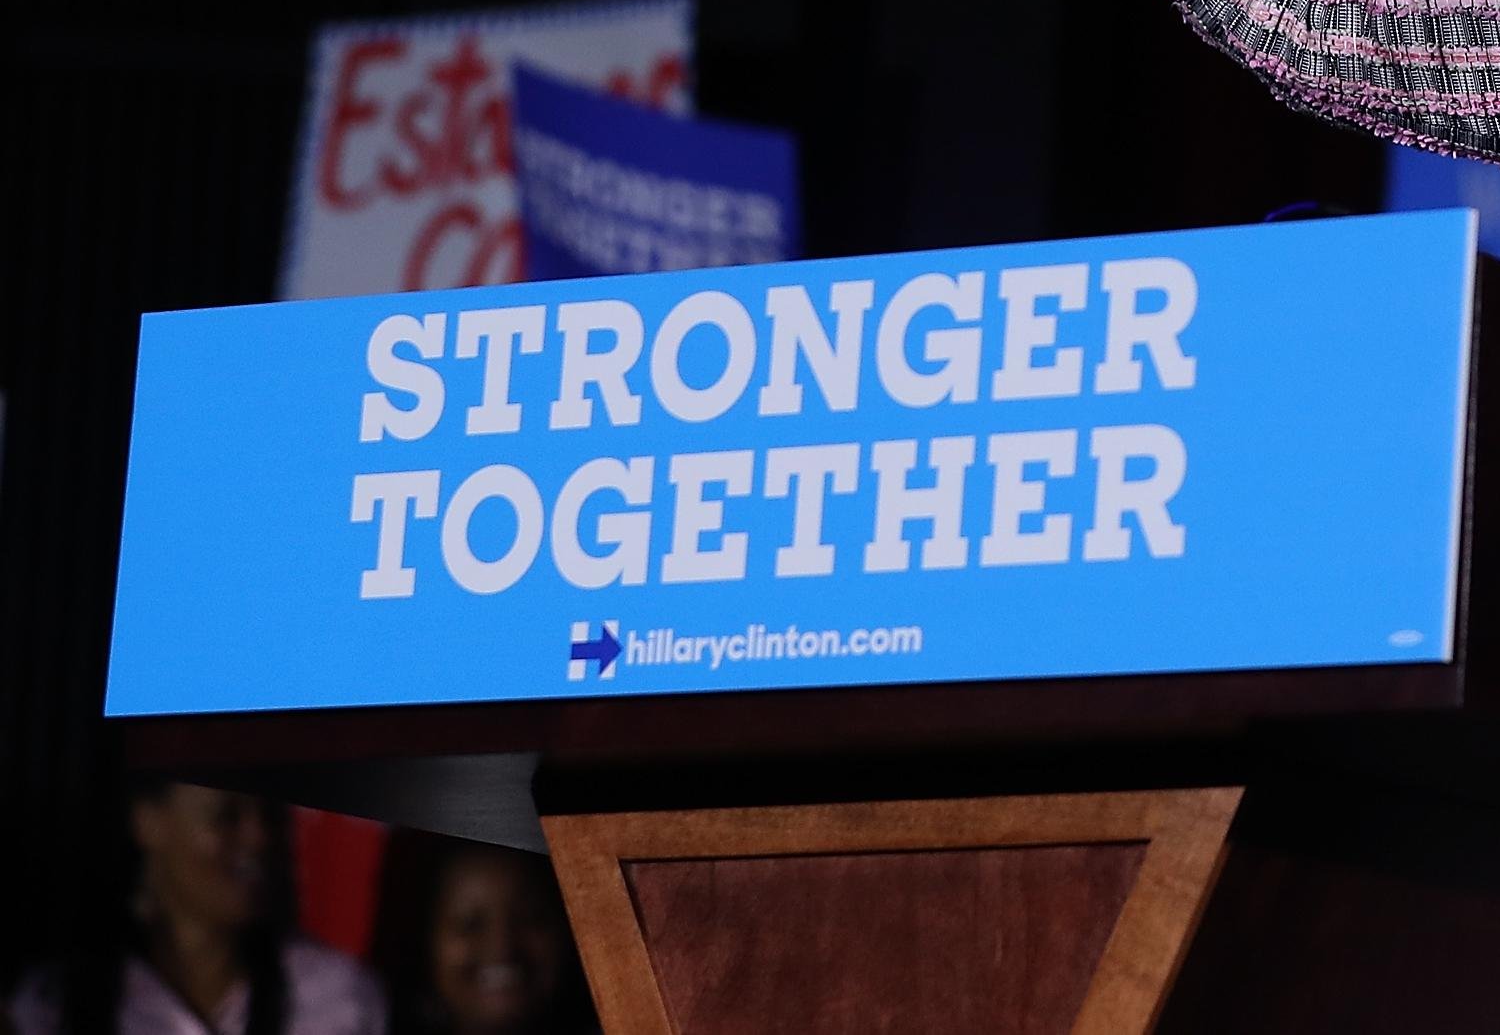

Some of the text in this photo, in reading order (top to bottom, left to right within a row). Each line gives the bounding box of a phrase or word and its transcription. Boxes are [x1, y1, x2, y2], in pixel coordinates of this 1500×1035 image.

[360, 257, 1198, 443] STRONGER
[350, 423, 1190, 601] TOGETHER
[625, 624, 924, 670] hillaryclinton.com
